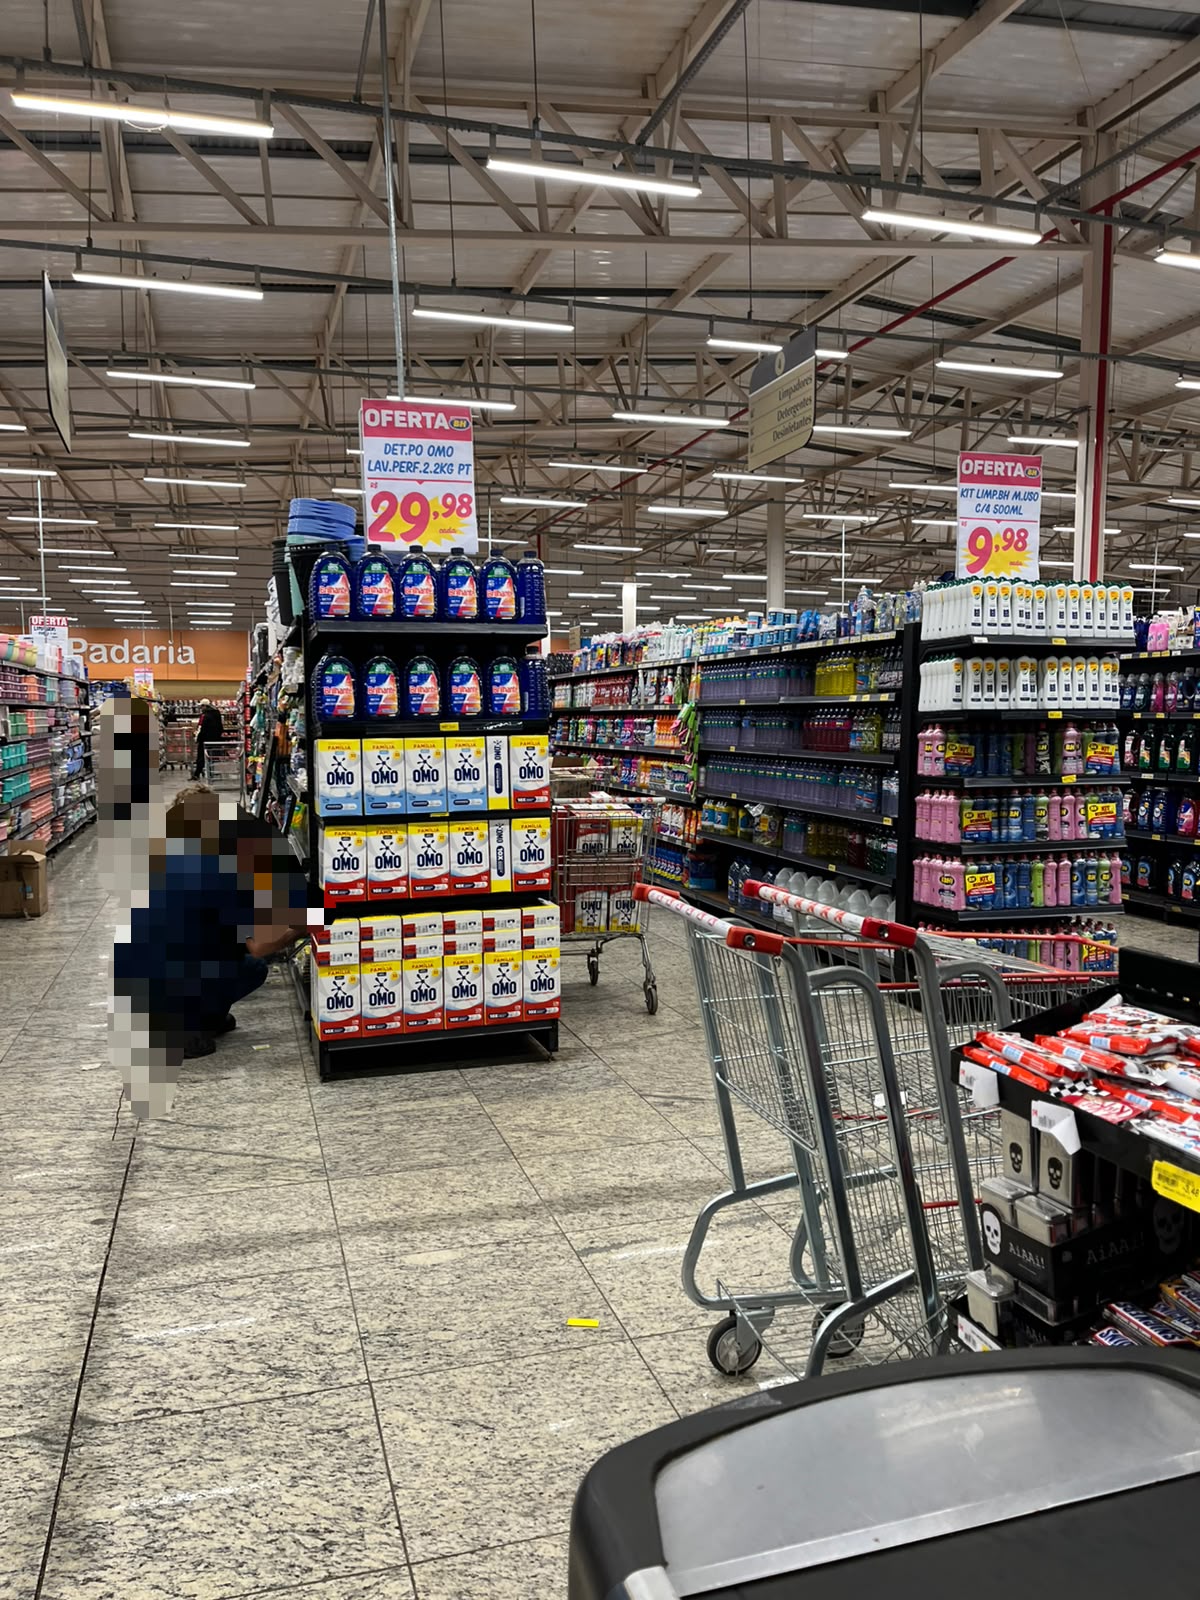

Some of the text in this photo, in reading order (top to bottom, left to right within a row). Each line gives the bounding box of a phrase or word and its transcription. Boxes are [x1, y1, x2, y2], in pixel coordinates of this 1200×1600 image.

[777, 396, 812, 422] Detergentes
[364, 408, 450, 430] OFERTA
[383, 443, 454, 458] DET.PO OMO
[367, 460, 472, 476] LAV.PERF.2.2KG PT
[961, 459, 1025, 478] OFERTA
[960, 488, 1039, 502] KIT LIMP.BH M.USO
[368, 490, 473, 543] 29,98
[975, 503, 1023, 515] C/4 500ML
[966, 526, 1029, 574] 9,98
[31, 616, 68, 626] OFERTA
[68, 637, 196, 665] Padaria
[494, 746, 502, 760] OMO
[326, 770, 354, 786] OMO
[371, 770, 398, 784] OMO
[412, 768, 439, 782] OMO
[454, 767, 480, 782] OMO
[519, 766, 544, 780] OMO
[496, 829, 504, 844] OMO
[374, 854, 402, 870] OMO
[416, 852, 443, 868] OMO
[456, 850, 483, 866] OMO
[520, 848, 545, 862] OMO
[332, 857, 360, 871] OMO
[452, 983, 477, 999] OMO
[492, 980, 517, 996] OMO
[530, 977, 555, 992] OMO
[326, 994, 354, 1010] OMO
[368, 991, 396, 1006] OMO
[410, 987, 437, 1003] OMO
